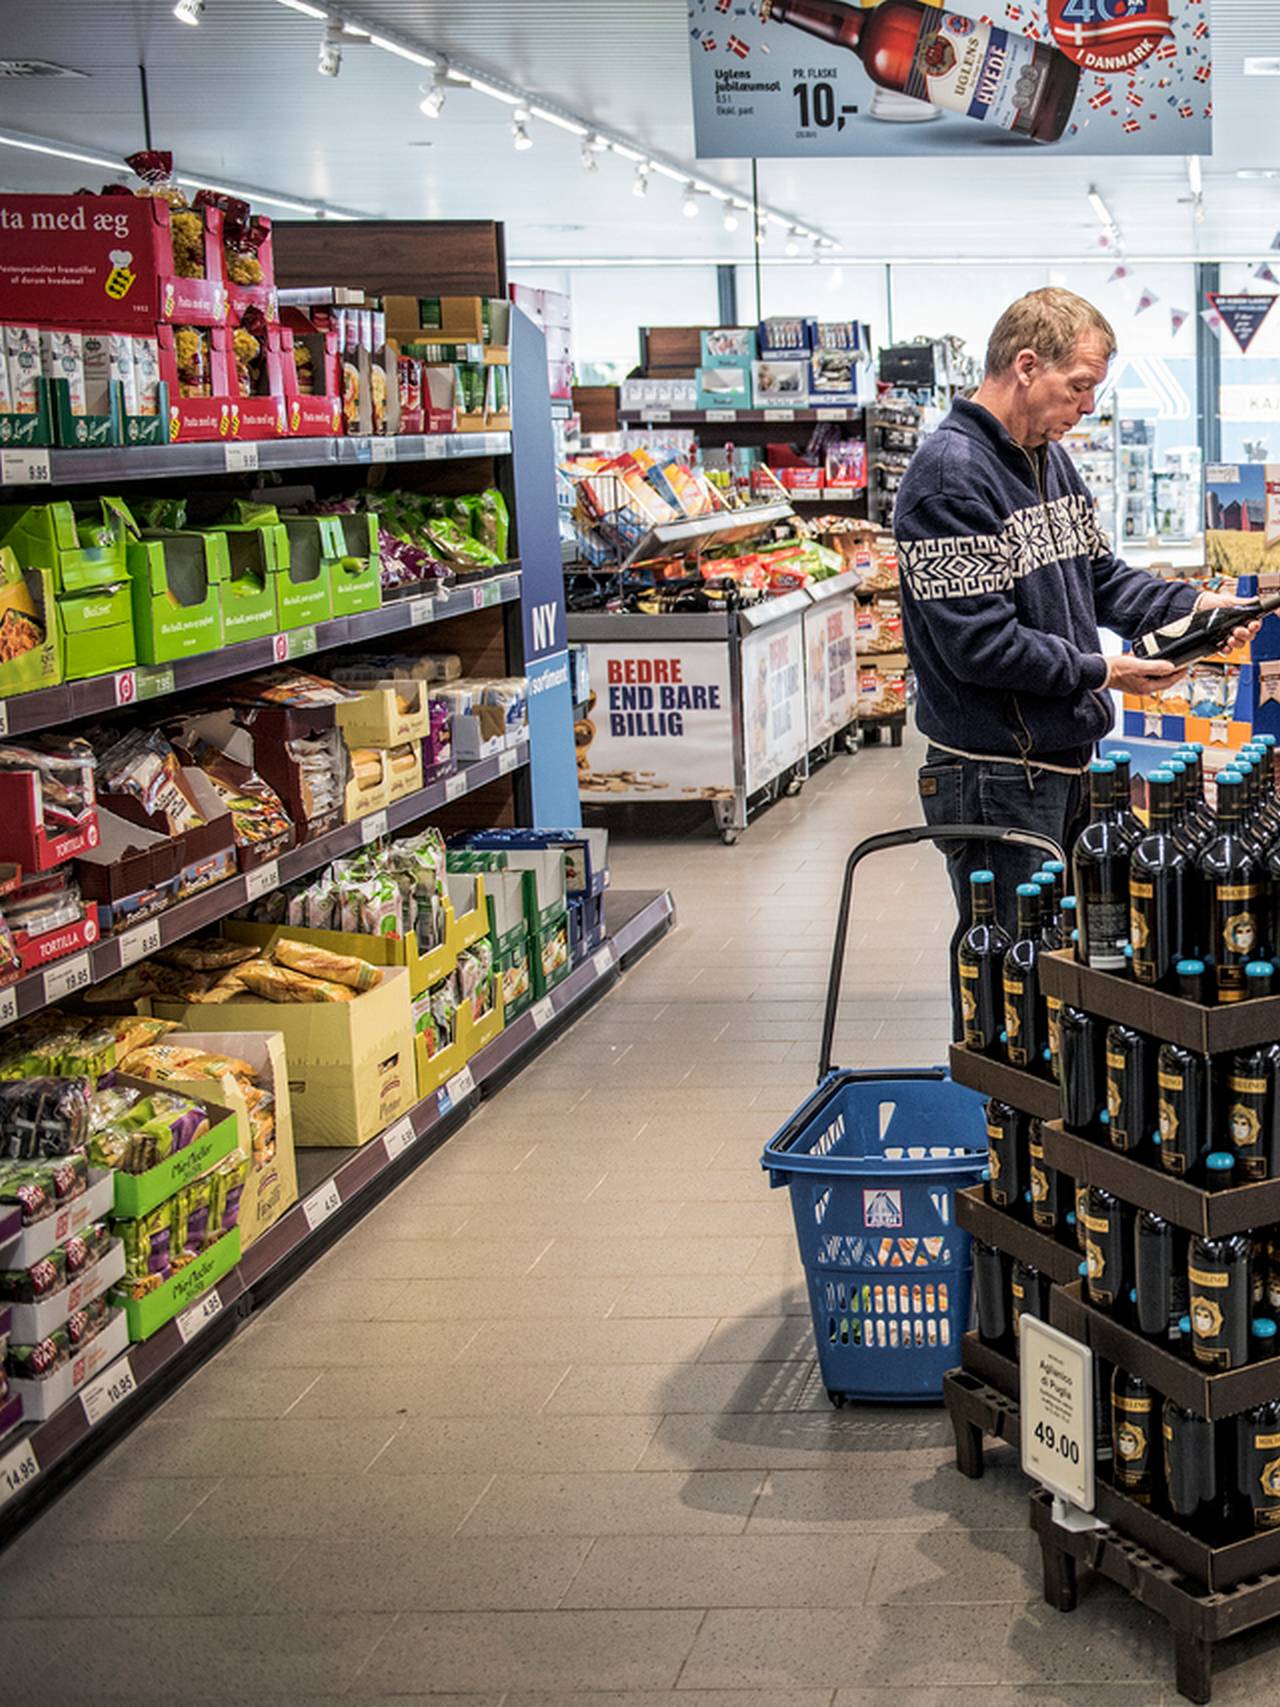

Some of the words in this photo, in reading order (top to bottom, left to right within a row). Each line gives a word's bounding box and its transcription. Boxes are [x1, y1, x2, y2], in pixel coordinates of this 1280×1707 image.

[955, 38, 979, 96] UGLENS
[1085, 38, 1154, 69] DANMARK
[715, 70, 751, 81] Uglens
[793, 69, 806, 78] PR.
[808, 68, 837, 78] FLASKE
[976, 45, 1008, 105] HVEDE
[793, 83, 858, 131] 10,-
[31, 206, 86, 230] med
[93, 214, 129, 238] æg
[532, 602, 557, 650] NY
[607, 659, 683, 684] BEDRE
[609, 686, 653, 711] END
[660, 685, 721, 710] BARE
[610, 712, 684, 736] BILLIG
[40, 932, 80, 957] TORTILLA
[203, 1296, 221, 1316] 4.95
[107, 1375, 133, 1402] 10.95
[1034, 1421, 1080, 1465] 49.00
[5, 1457, 36, 1490] 14.95
